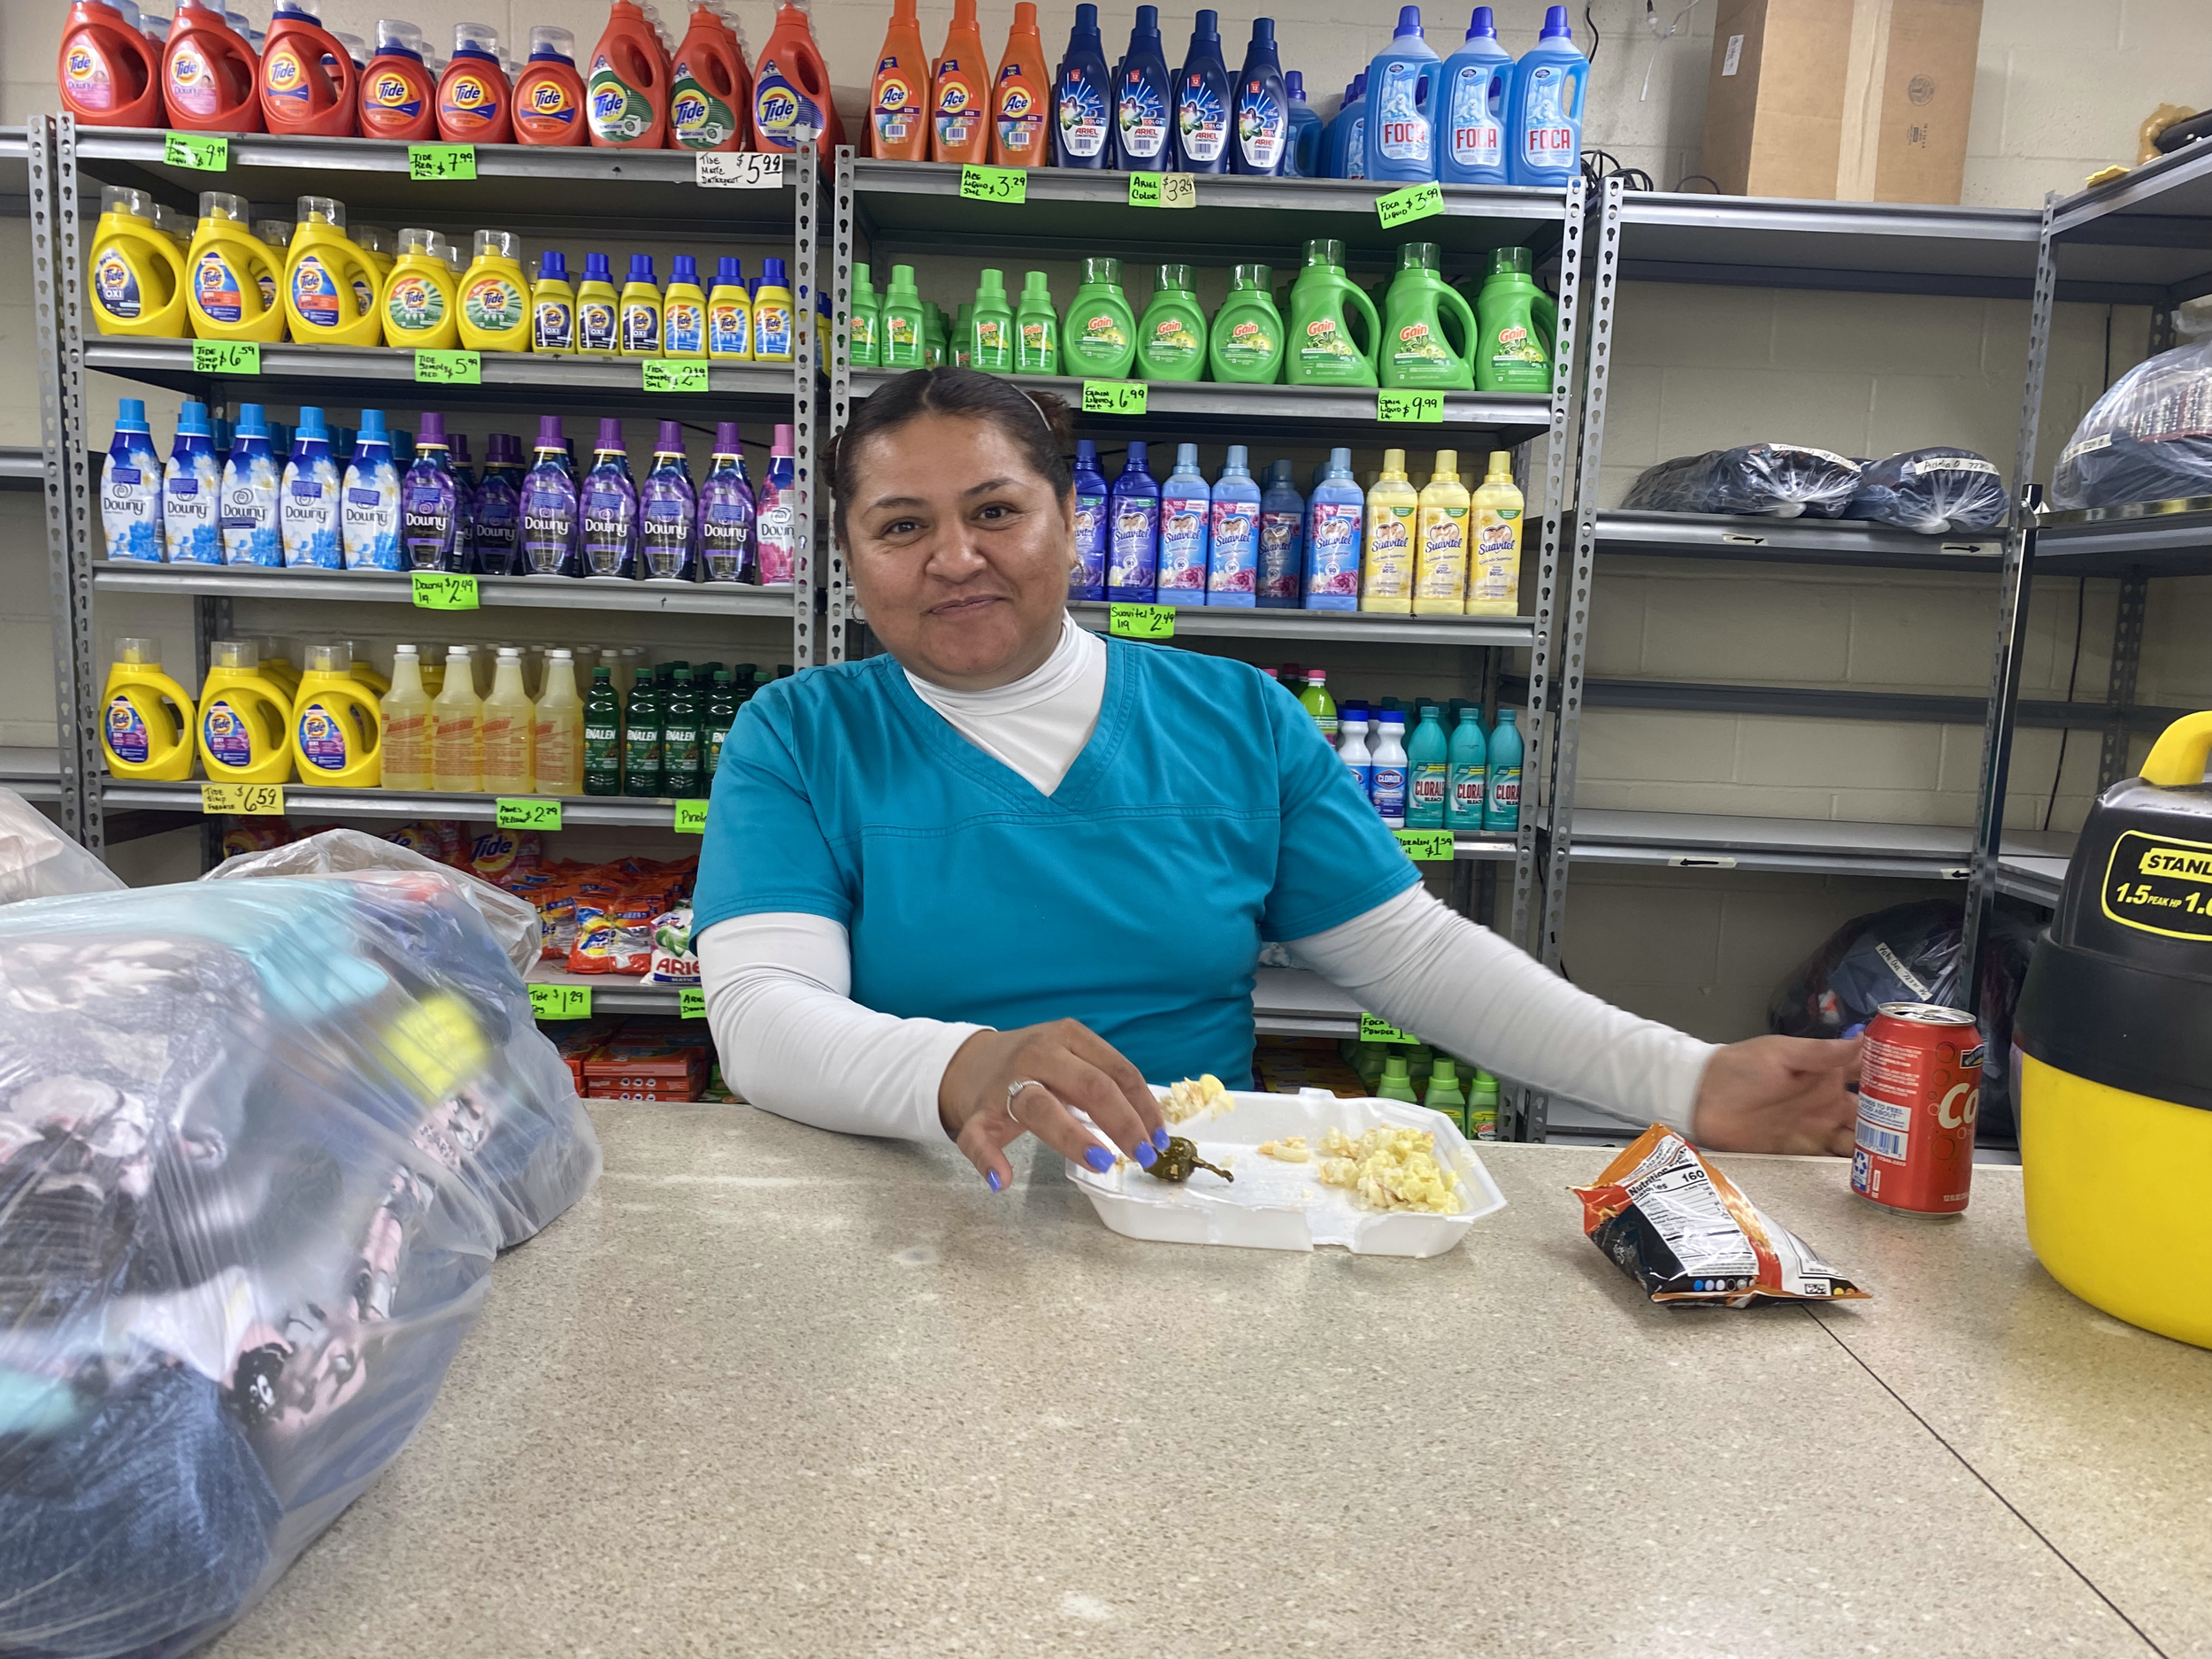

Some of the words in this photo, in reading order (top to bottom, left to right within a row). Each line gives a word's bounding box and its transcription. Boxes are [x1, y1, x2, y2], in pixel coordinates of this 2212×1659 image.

[69, 56, 90, 70] Tide
[175, 62, 196, 76] Tide
[272, 63, 296, 82] Tide
[380, 81, 404, 99] Tide
[456, 84, 480, 102] Tide
[879, 88, 904, 104] Ace
[534, 90, 561, 107] Tide
[594, 93, 624, 118] Tide
[941, 91, 965, 107] Ace
[1002, 96, 1029, 111] Ace
[675, 102, 705, 126] Tide
[759, 99, 795, 122] Tide
[1455, 127, 1497, 149] FOCA
[1529, 129, 1571, 150] FOCA
[699, 154, 721, 166] TIDE
[964, 170, 982, 180] ACE
[1133, 176, 1158, 189] ARIEL
[1379, 201, 1401, 212] FOCA
[104, 268, 125, 284] Tide
[204, 271, 222, 284] Tide
[301, 274, 319, 289] Tide
[105, 289, 122, 298] OXI
[405, 290, 425, 305] Tide
[484, 291, 504, 306] Tide
[544, 312, 562, 324] Tide
[590, 314, 607, 325] Tide
[633, 314, 649, 326] Tide
[676, 315, 691, 325] Tide
[720, 317, 737, 328] Tide
[765, 318, 780, 329] Tide
[888, 318, 906, 330] Gain
[1087, 317, 1113, 331] Gain
[979, 323, 998, 334] Gain
[1023, 325, 1042, 335] Gain
[1157, 320, 1182, 334] Gain
[1233, 323, 1258, 336] Gain
[1307, 320, 1335, 335] Gain
[1400, 324, 1429, 342] Gain
[1499, 327, 1527, 344] Gain
[195, 346, 217, 356] TIDE
[1379, 396, 1402, 407] GAIN
[1380, 405, 1402, 414] LIQUID
[104, 498, 145, 517] Downy
[167, 500, 209, 519] Downy
[224, 503, 266, 522] Downy
[285, 505, 327, 524] Downy
[346, 509, 388, 526] Downy
[406, 512, 447, 531] Downy
[524, 516, 569, 535] Downy
[585, 518, 627, 538] Downy
[644, 521, 687, 540] Downy
[703, 523, 748, 541] Downy
[761, 523, 795, 537] Down
[1113, 529, 1150, 541] Suavitel
[1164, 531, 1202, 544] Suavitel
[1215, 533, 1252, 548] Suavitel
[1316, 534, 1353, 549] Suavitel
[1371, 537, 1409, 553] Suavitel
[1425, 537, 1463, 554] Suavitel
[1478, 539, 1516, 555] Suavitel
[415, 578, 443, 594] Downy
[1110, 606, 1148, 619] Suavitel
[111, 712, 130, 726] Tide
[212, 718, 230, 733] Tide
[305, 721, 326, 736] Tide
[1378, 774, 1401, 783] CLOROX
[471, 832, 513, 864] Tide
[2116, 882, 2153, 905] 1.5
[2147, 895, 2170, 907] PEAK
[2169, 899, 2183, 909] HP
[531, 990, 549, 1002] Tide
[1363, 1017, 1386, 1025] FOCA
[1362, 1026, 1395, 1035] POWDER
[1628, 1168, 1669, 1196] Nutrition
[1681, 1170, 1706, 1183] 160
